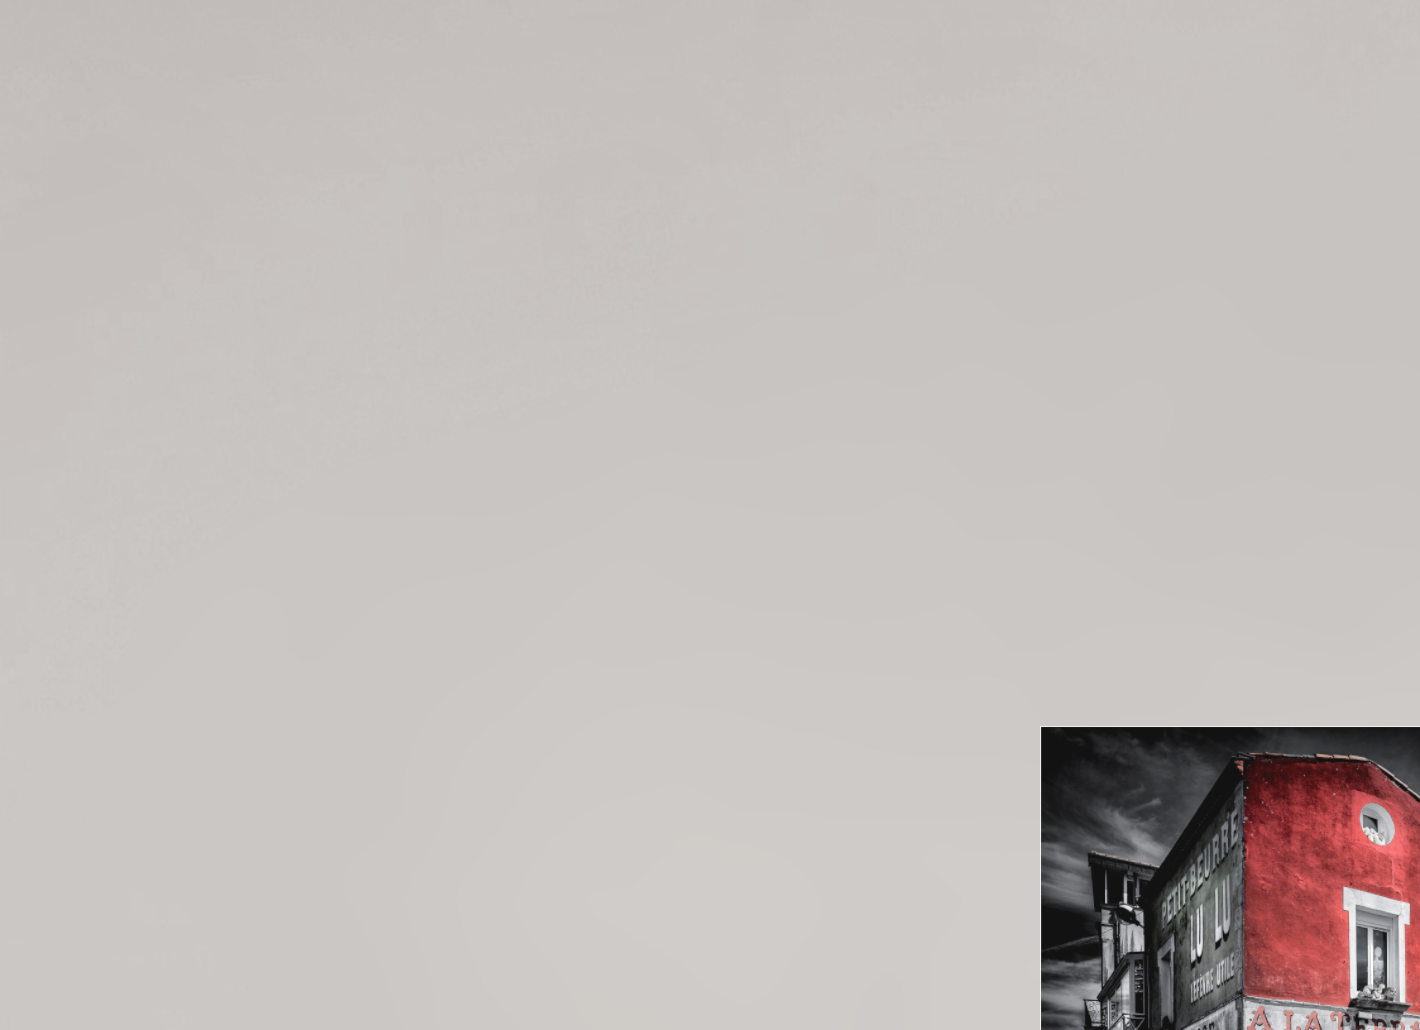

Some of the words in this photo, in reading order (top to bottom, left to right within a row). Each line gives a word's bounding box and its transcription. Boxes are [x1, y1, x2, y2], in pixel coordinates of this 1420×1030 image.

[1190, 903, 1204, 964] LU
[1214, 873, 1231, 943] LU
[1216, 952, 1235, 987] UTILE
